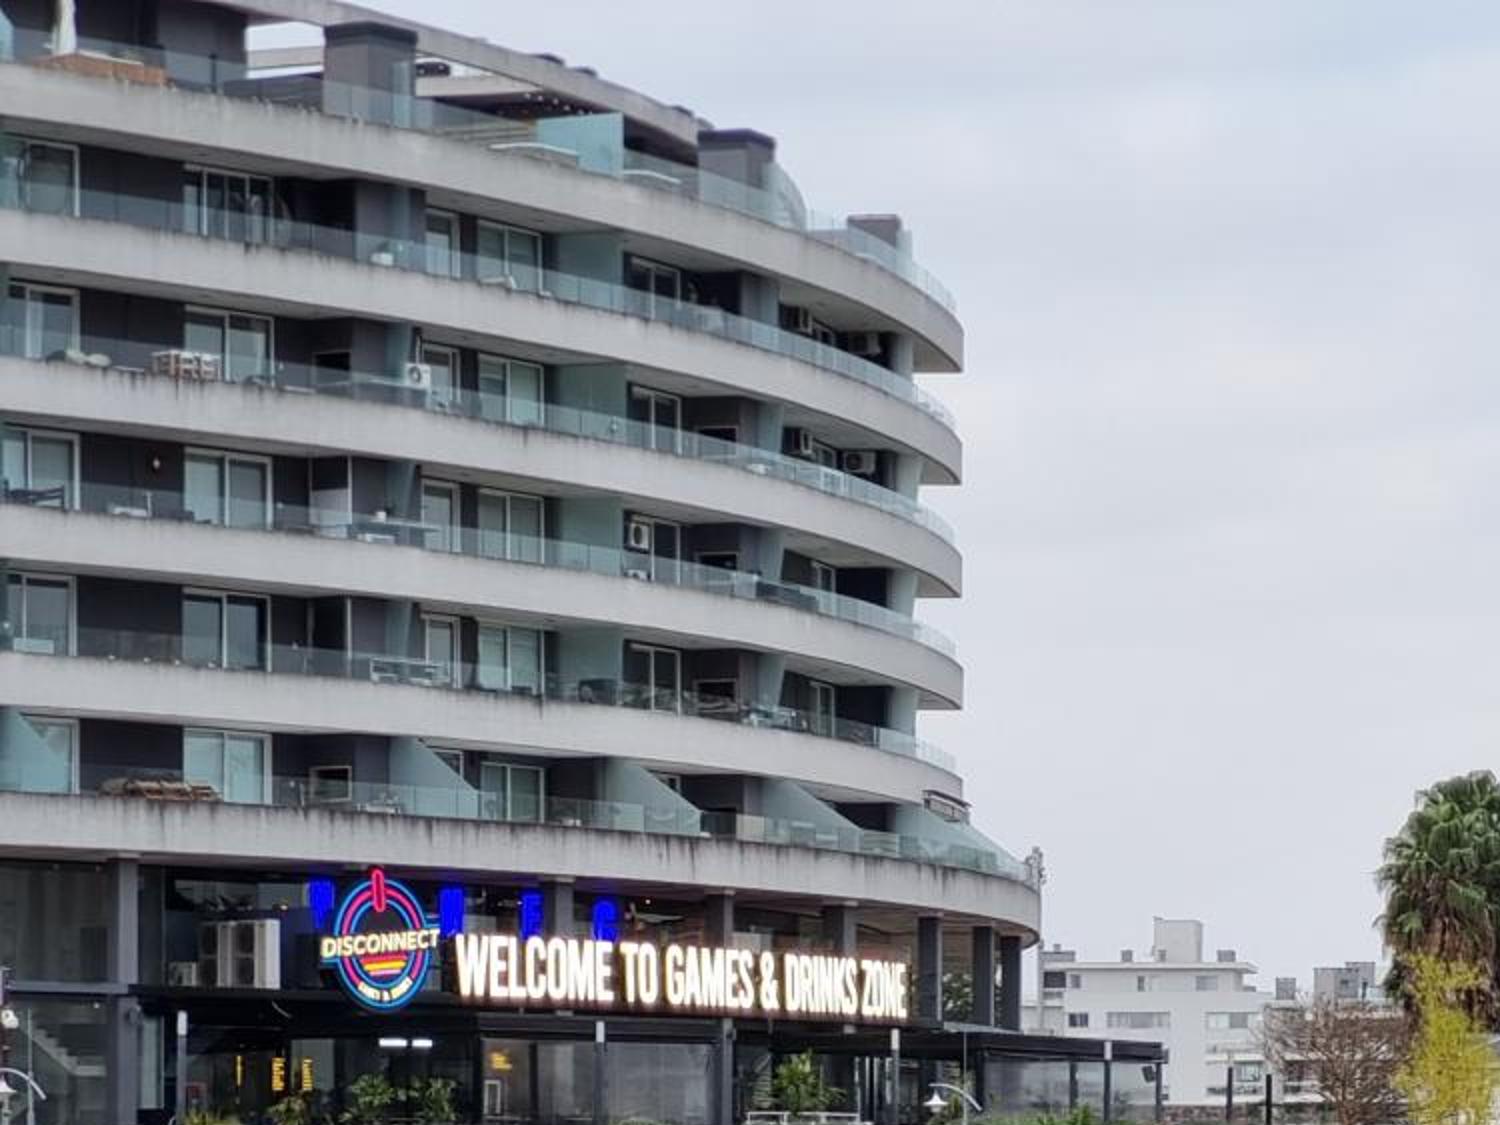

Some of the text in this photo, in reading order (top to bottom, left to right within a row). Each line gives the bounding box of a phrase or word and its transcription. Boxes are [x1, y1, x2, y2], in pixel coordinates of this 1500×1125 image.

[320, 927, 440, 958] DISCONNECT
[456, 934, 908, 1018] WELCOME TO GAMES & DRINKS ZONE
